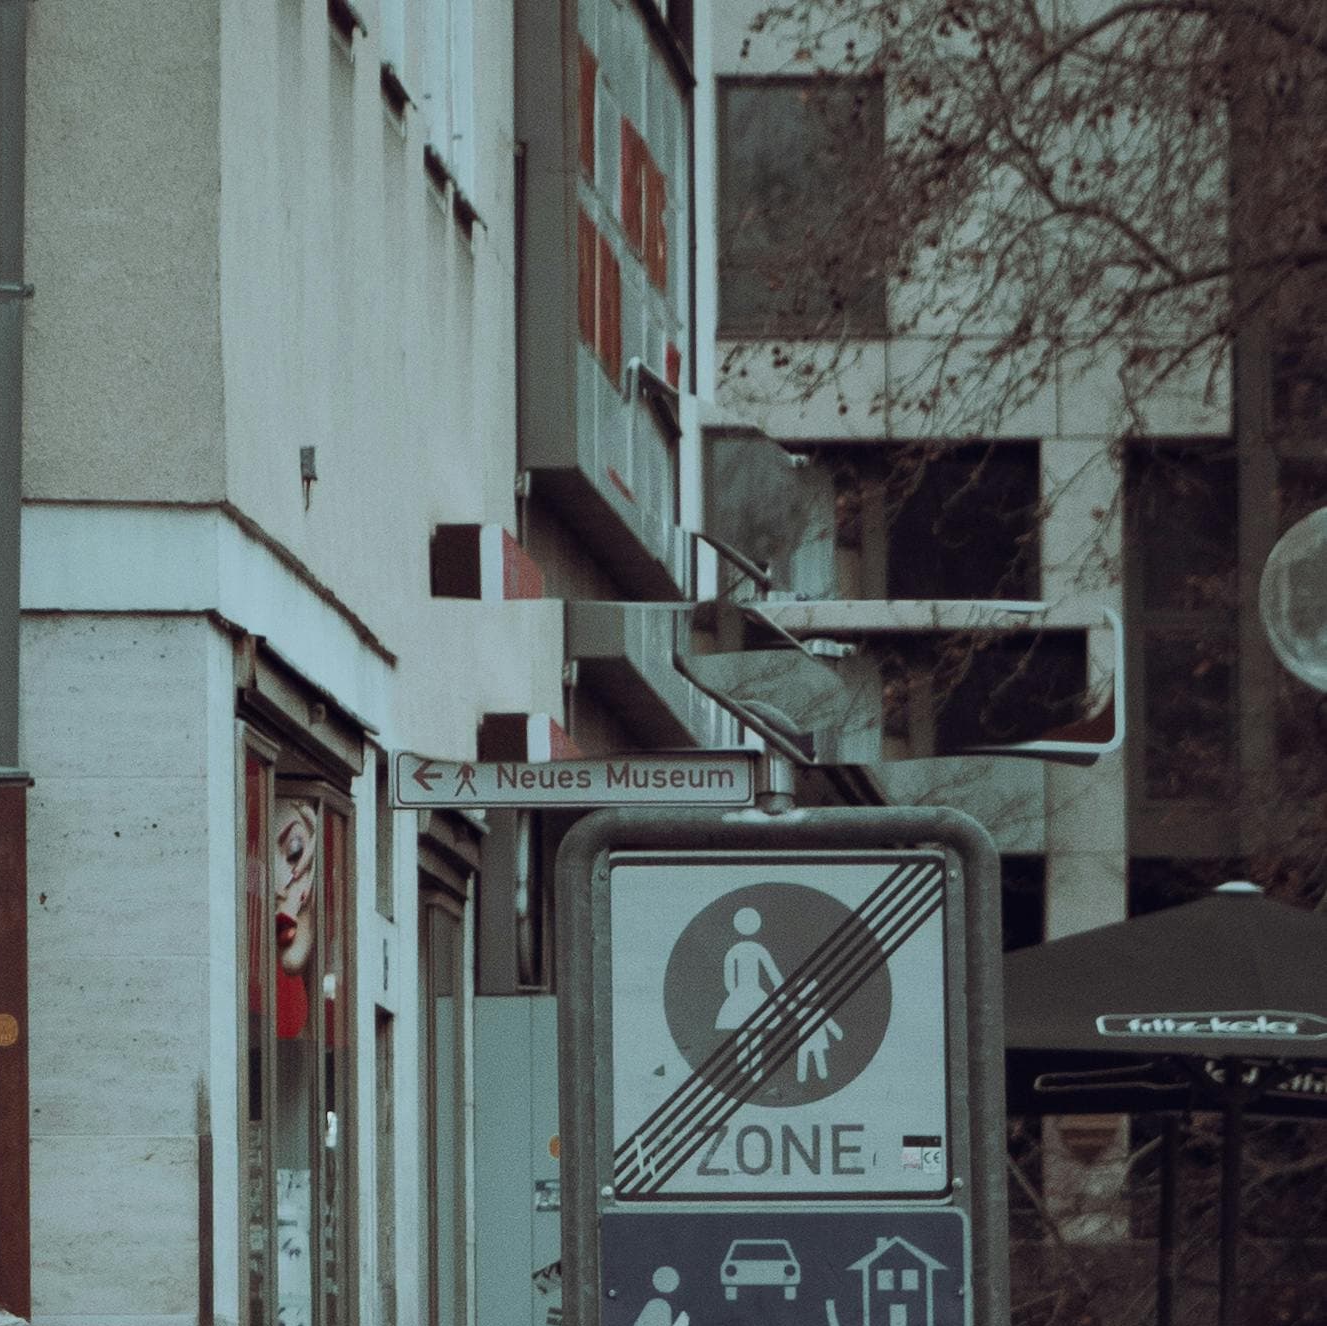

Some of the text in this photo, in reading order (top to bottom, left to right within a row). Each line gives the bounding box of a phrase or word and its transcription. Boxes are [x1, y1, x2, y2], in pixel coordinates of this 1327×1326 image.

[496, 763, 734, 789] Neues Museum
[695, 1124, 866, 1177] ZONE
